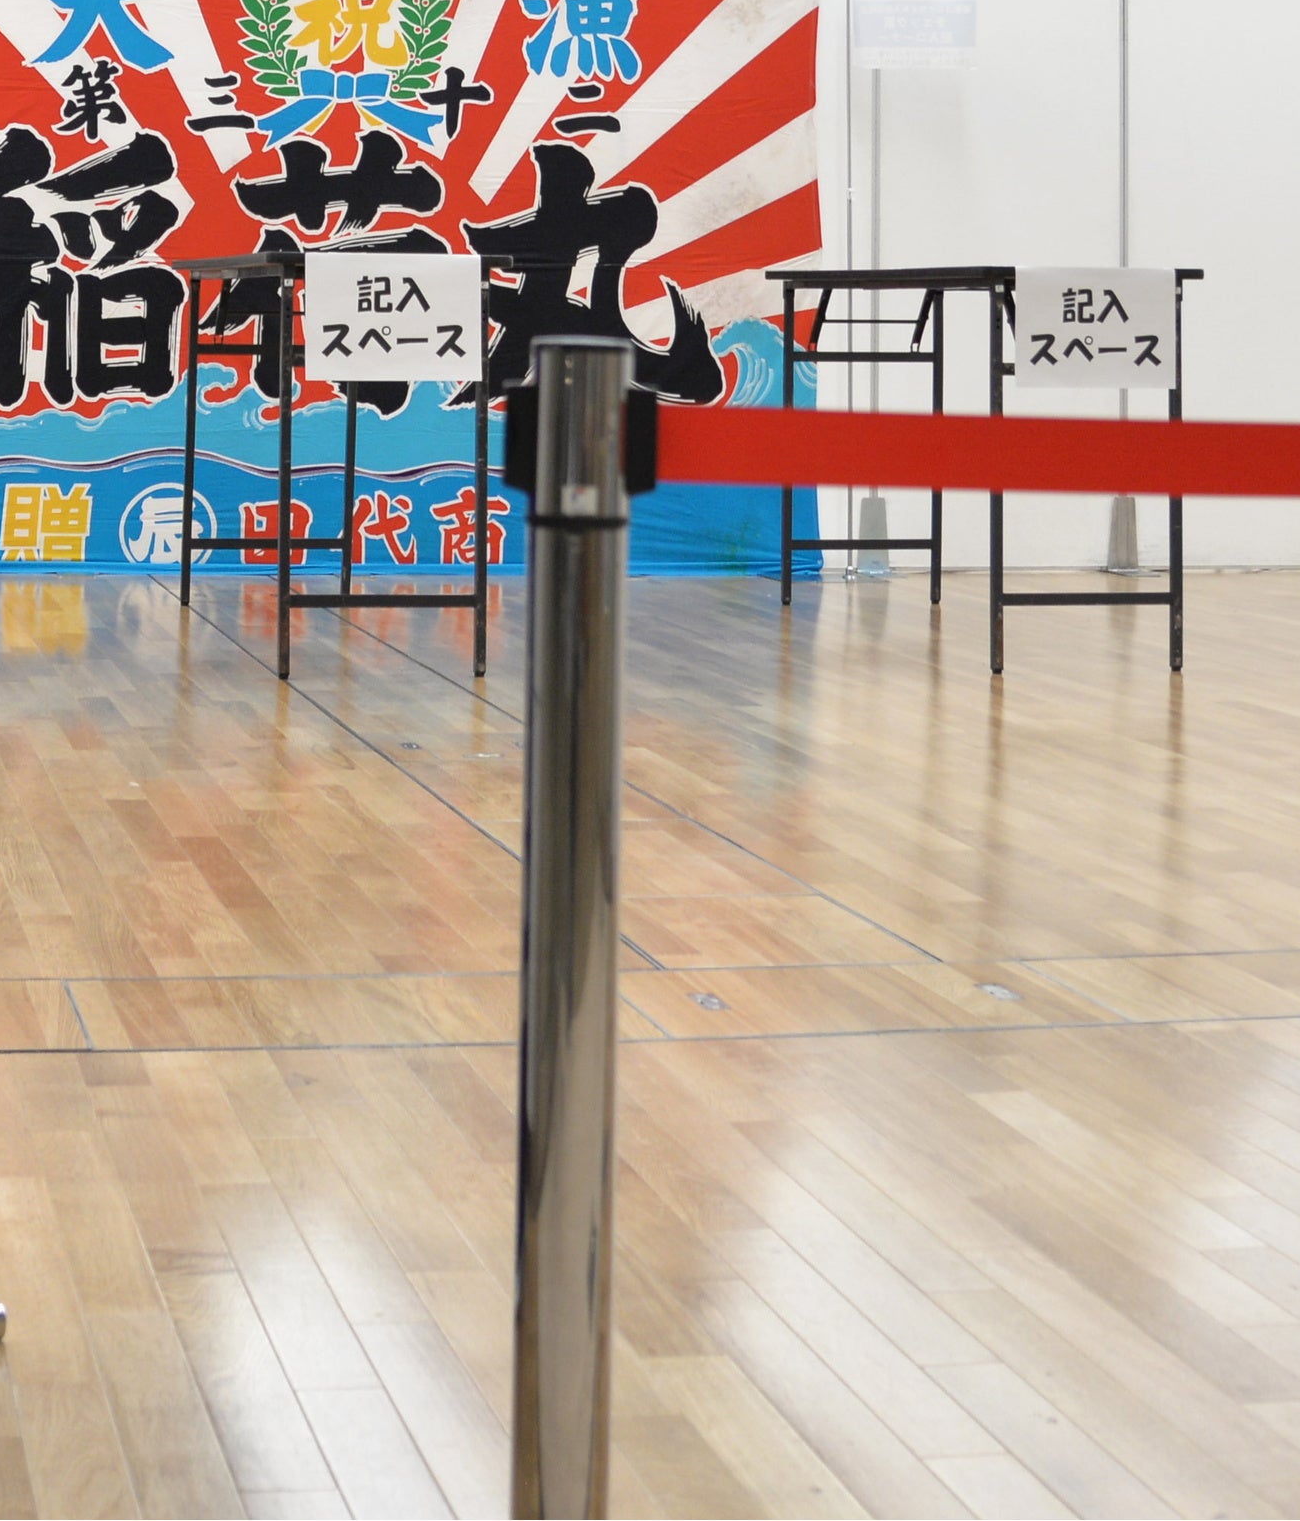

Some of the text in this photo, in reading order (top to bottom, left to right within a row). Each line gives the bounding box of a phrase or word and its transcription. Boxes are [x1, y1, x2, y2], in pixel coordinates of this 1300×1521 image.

[356, 275, 431, 313] 記入
[1062, 287, 1130, 324] 記入
[322, 323, 467, 358] スペース
[1029, 333, 1162, 367] スペース
